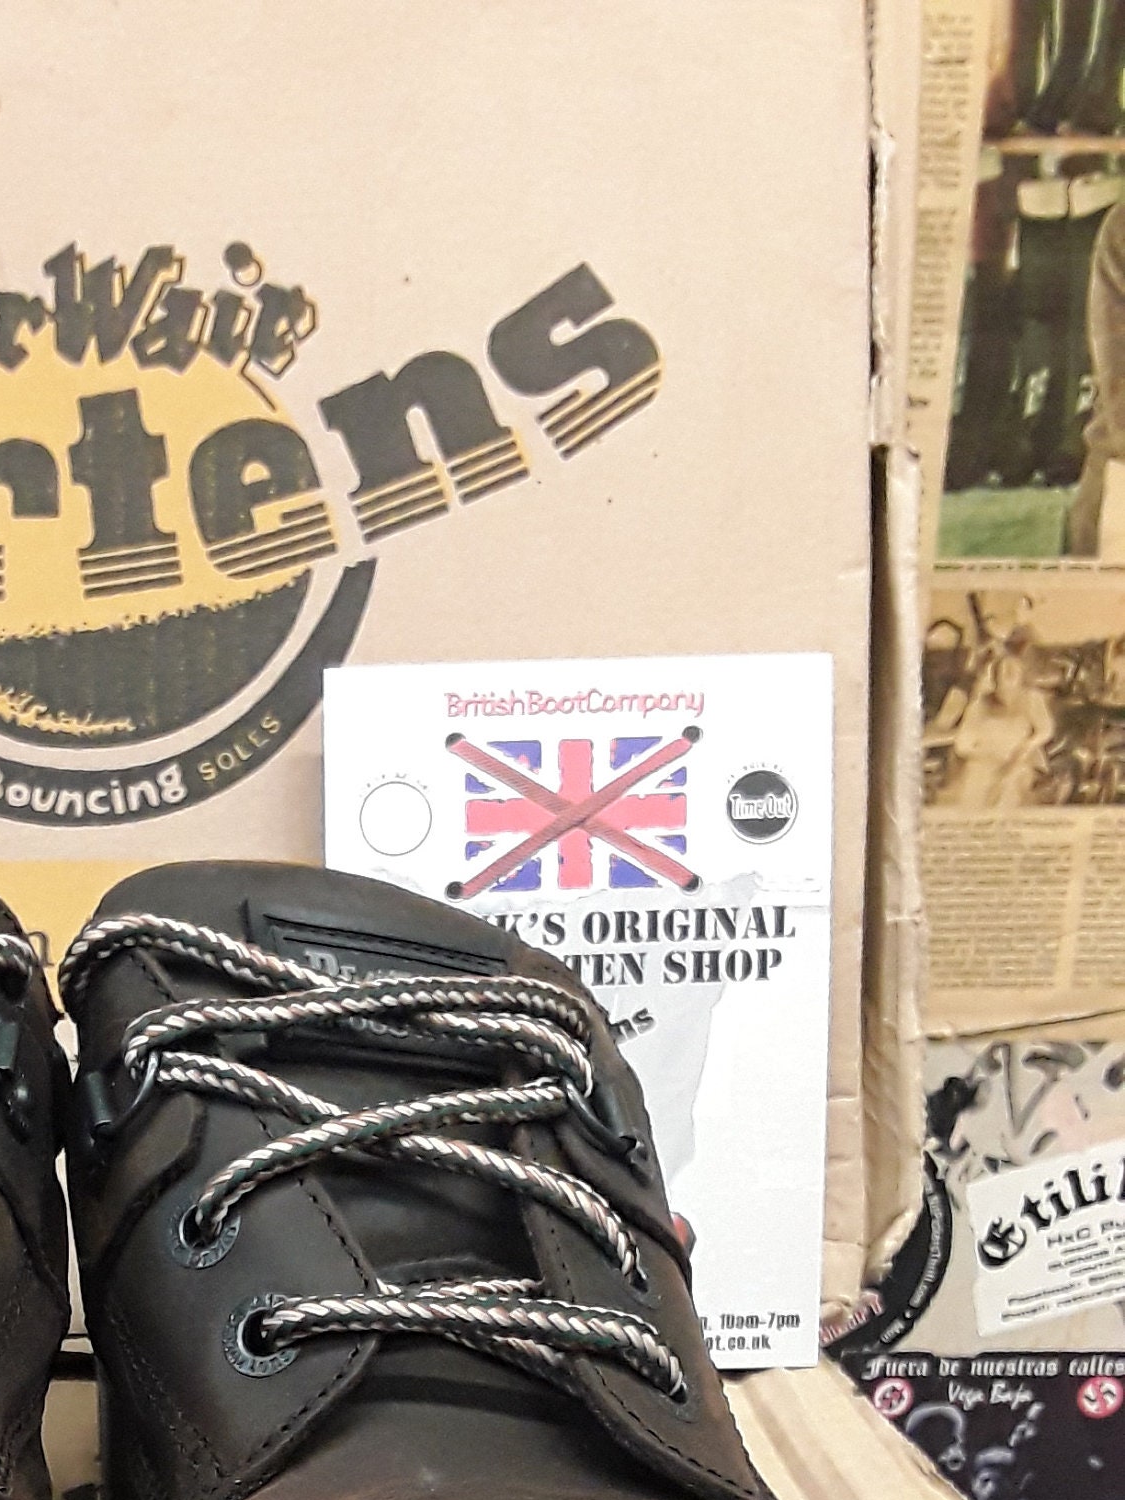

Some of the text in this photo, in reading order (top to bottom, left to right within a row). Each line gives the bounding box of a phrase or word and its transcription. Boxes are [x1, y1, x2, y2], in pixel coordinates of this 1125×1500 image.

[197, 715, 281, 782] SOLES
[582, 904, 797, 945] ORIGINAL
[662, 948, 783, 985] SHOP
